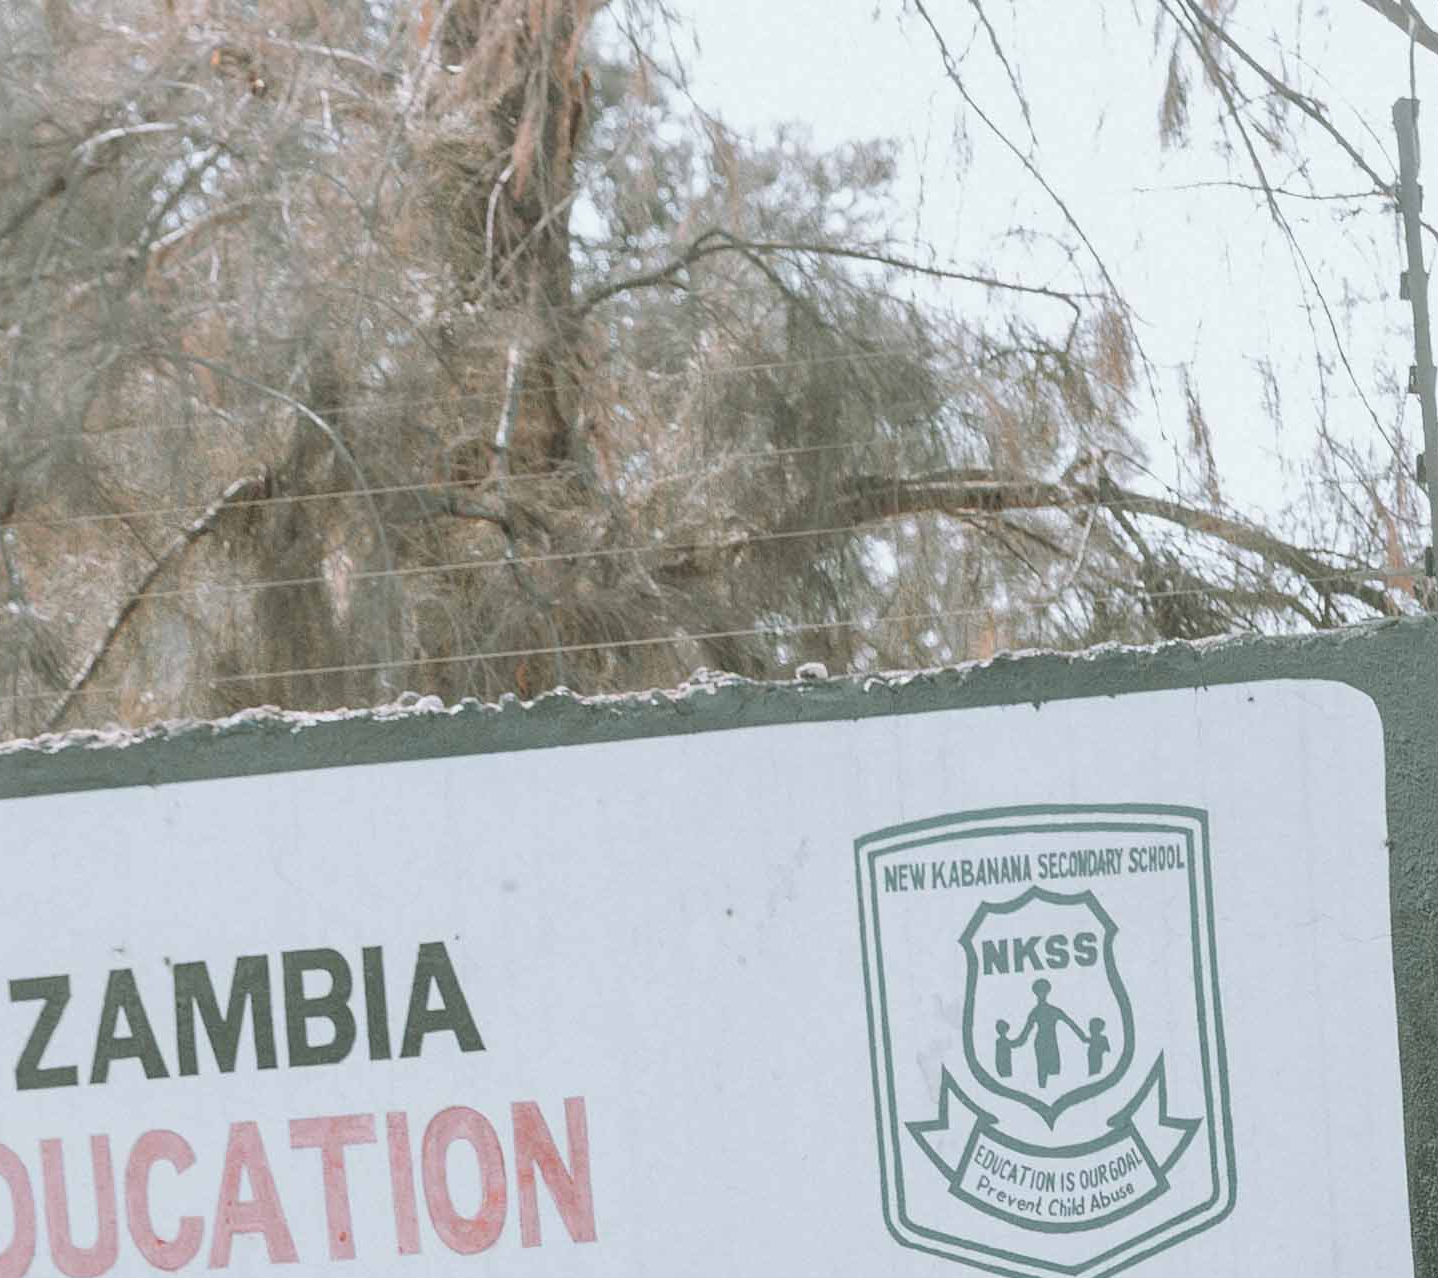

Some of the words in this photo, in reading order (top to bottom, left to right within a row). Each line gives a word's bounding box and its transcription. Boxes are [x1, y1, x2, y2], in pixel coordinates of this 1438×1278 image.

[883, 863, 926, 892] NEW
[931, 854, 1032, 889] KABANANA
[1038, 847, 1123, 880] SECONDARY
[1128, 843, 1185, 873] SCHOOL
[981, 931, 1099, 976] NKSS
[8, 941, 486, 1091] ZAMBIA
[974, 1144, 1056, 1193] EDUCATION
[1061, 1172, 1076, 1192] IS
[1079, 1165, 1110, 1190] OUR
[1109, 1147, 1145, 1182] GOAL
[976, 1175, 1043, 1216] Prevent
[1048, 1195, 1086, 1216] Child
[1090, 1182, 1135, 1213] Abuse
